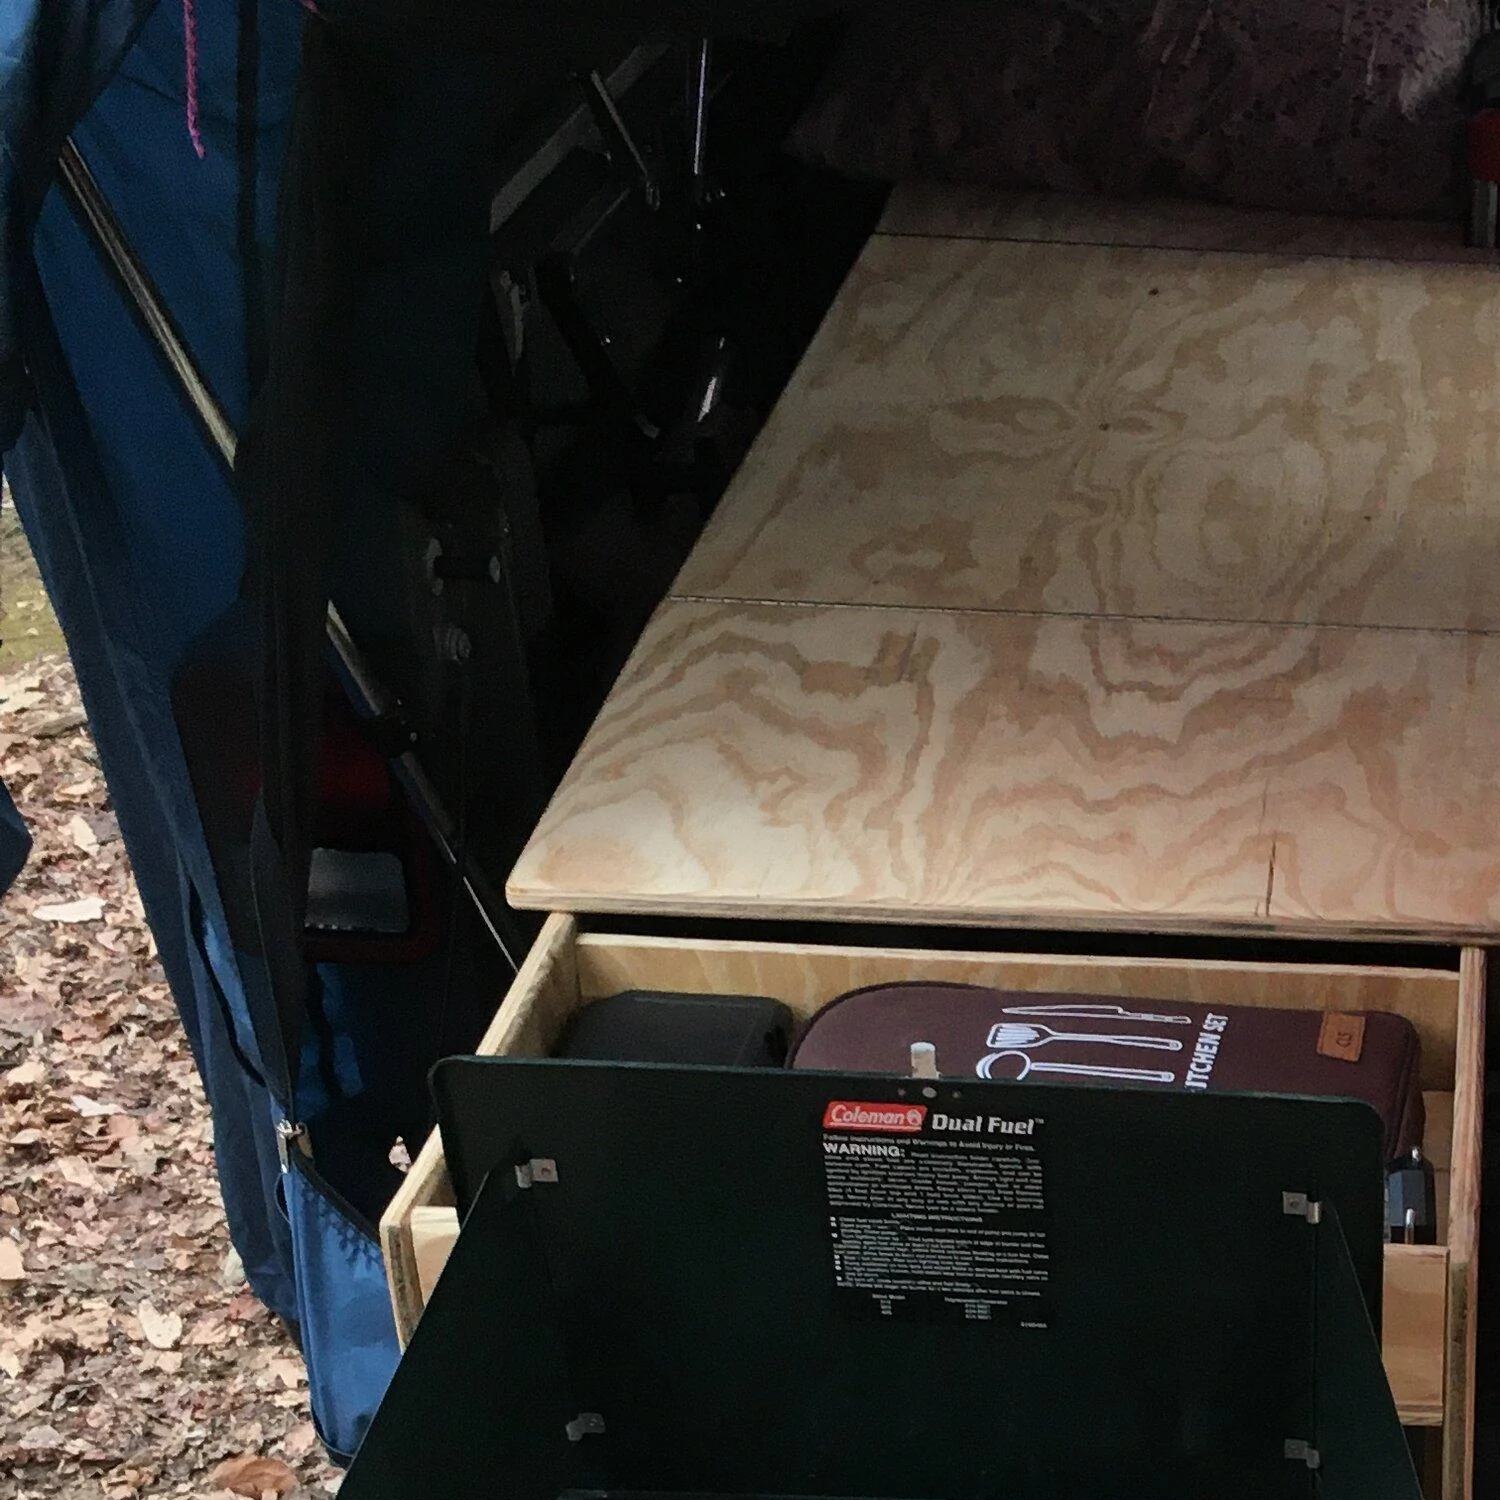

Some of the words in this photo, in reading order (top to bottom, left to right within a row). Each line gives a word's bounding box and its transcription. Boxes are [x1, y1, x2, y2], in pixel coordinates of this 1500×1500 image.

[1183, 1032, 1222, 1093] ITCHEN
[1203, 1012, 1229, 1032] SET
[830, 1104, 906, 1125] Coleman
[932, 1113, 983, 1132] Dual
[822, 1142, 906, 1158] WARNING:
